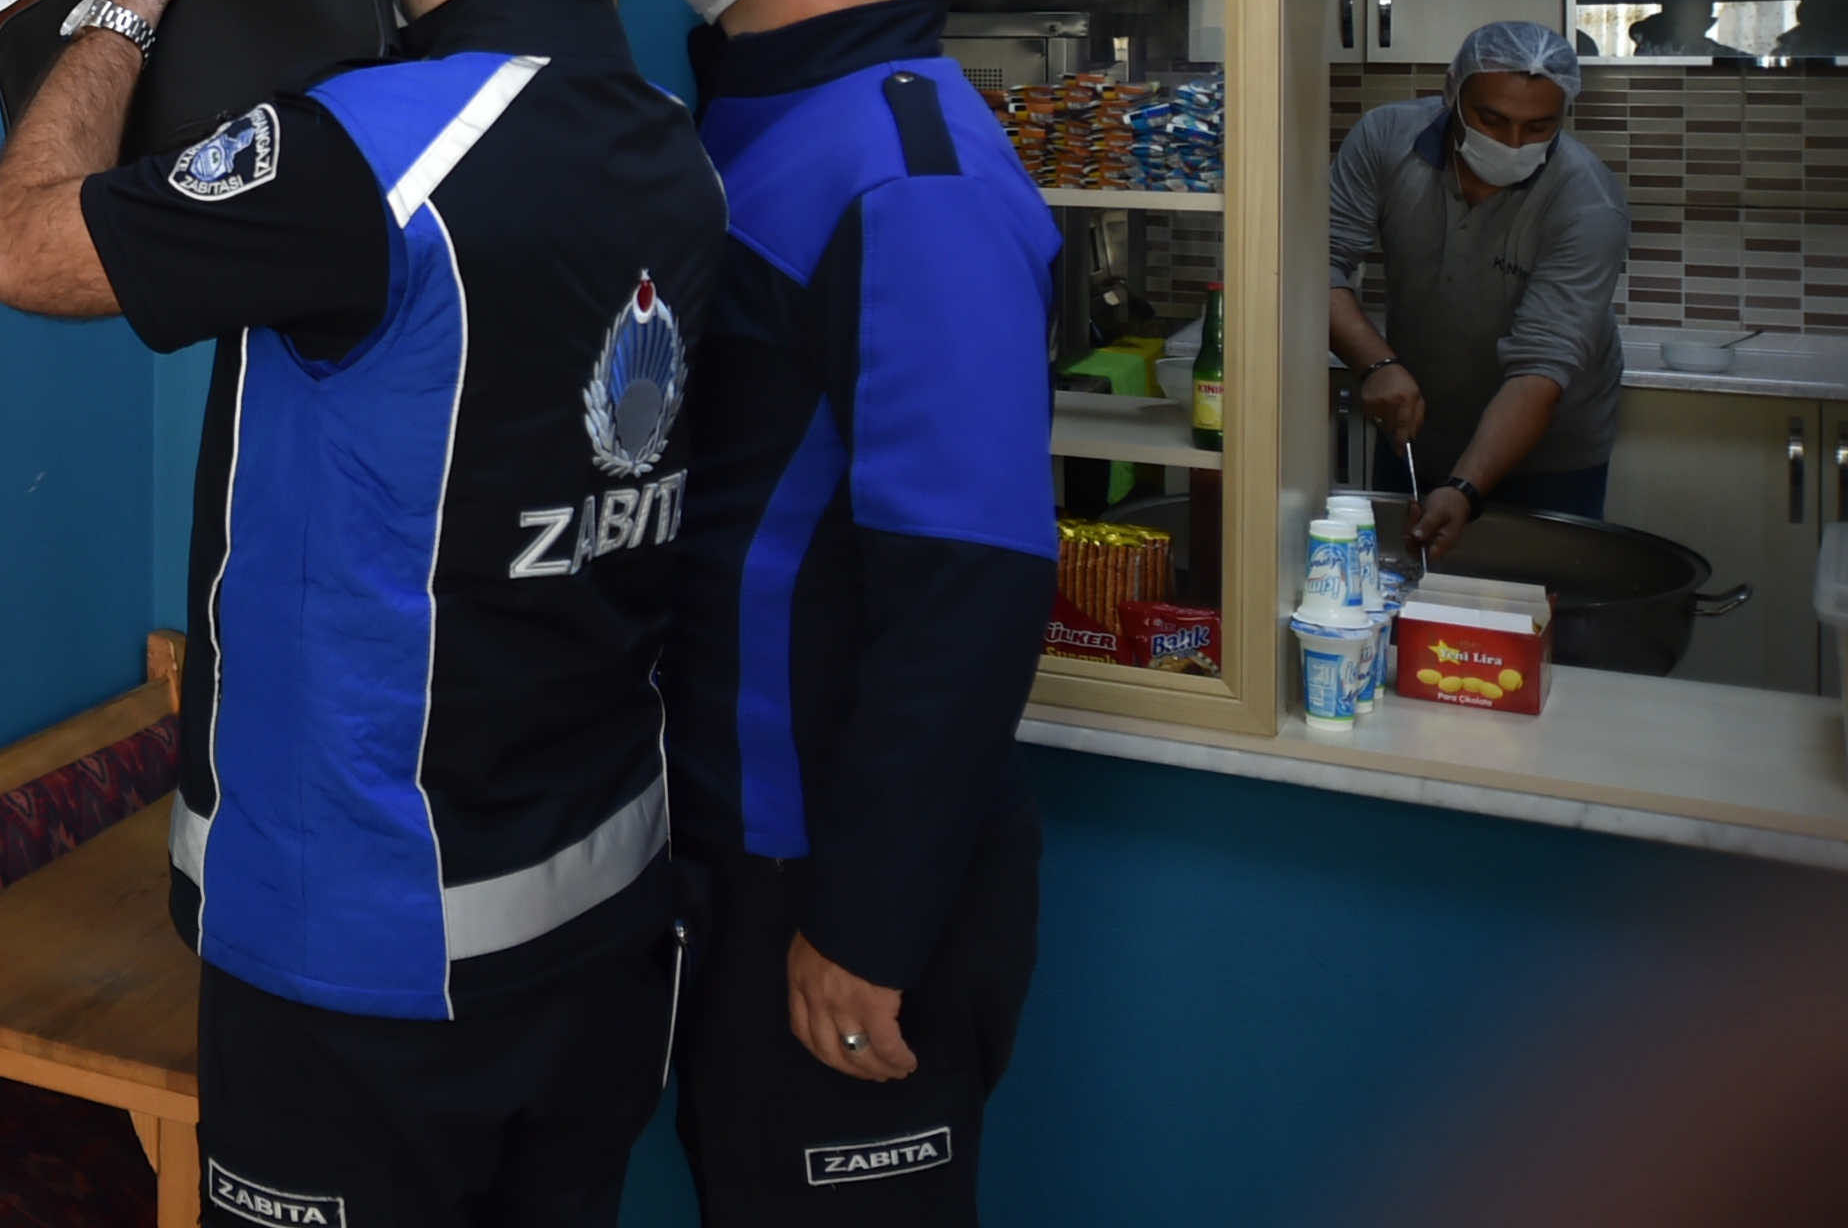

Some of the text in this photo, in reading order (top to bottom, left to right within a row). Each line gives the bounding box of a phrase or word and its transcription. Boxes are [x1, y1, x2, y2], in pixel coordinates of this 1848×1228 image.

[179, 175, 245, 195] ZABITASI
[1045, 621, 1118, 652] ÜLKER
[1440, 648, 1503, 666] Yeni Lira
[1437, 692, 1493, 707] Para Çikolata
[824, 1140, 938, 1175] ZABITA
[217, 1178, 328, 1226] ZABITA
